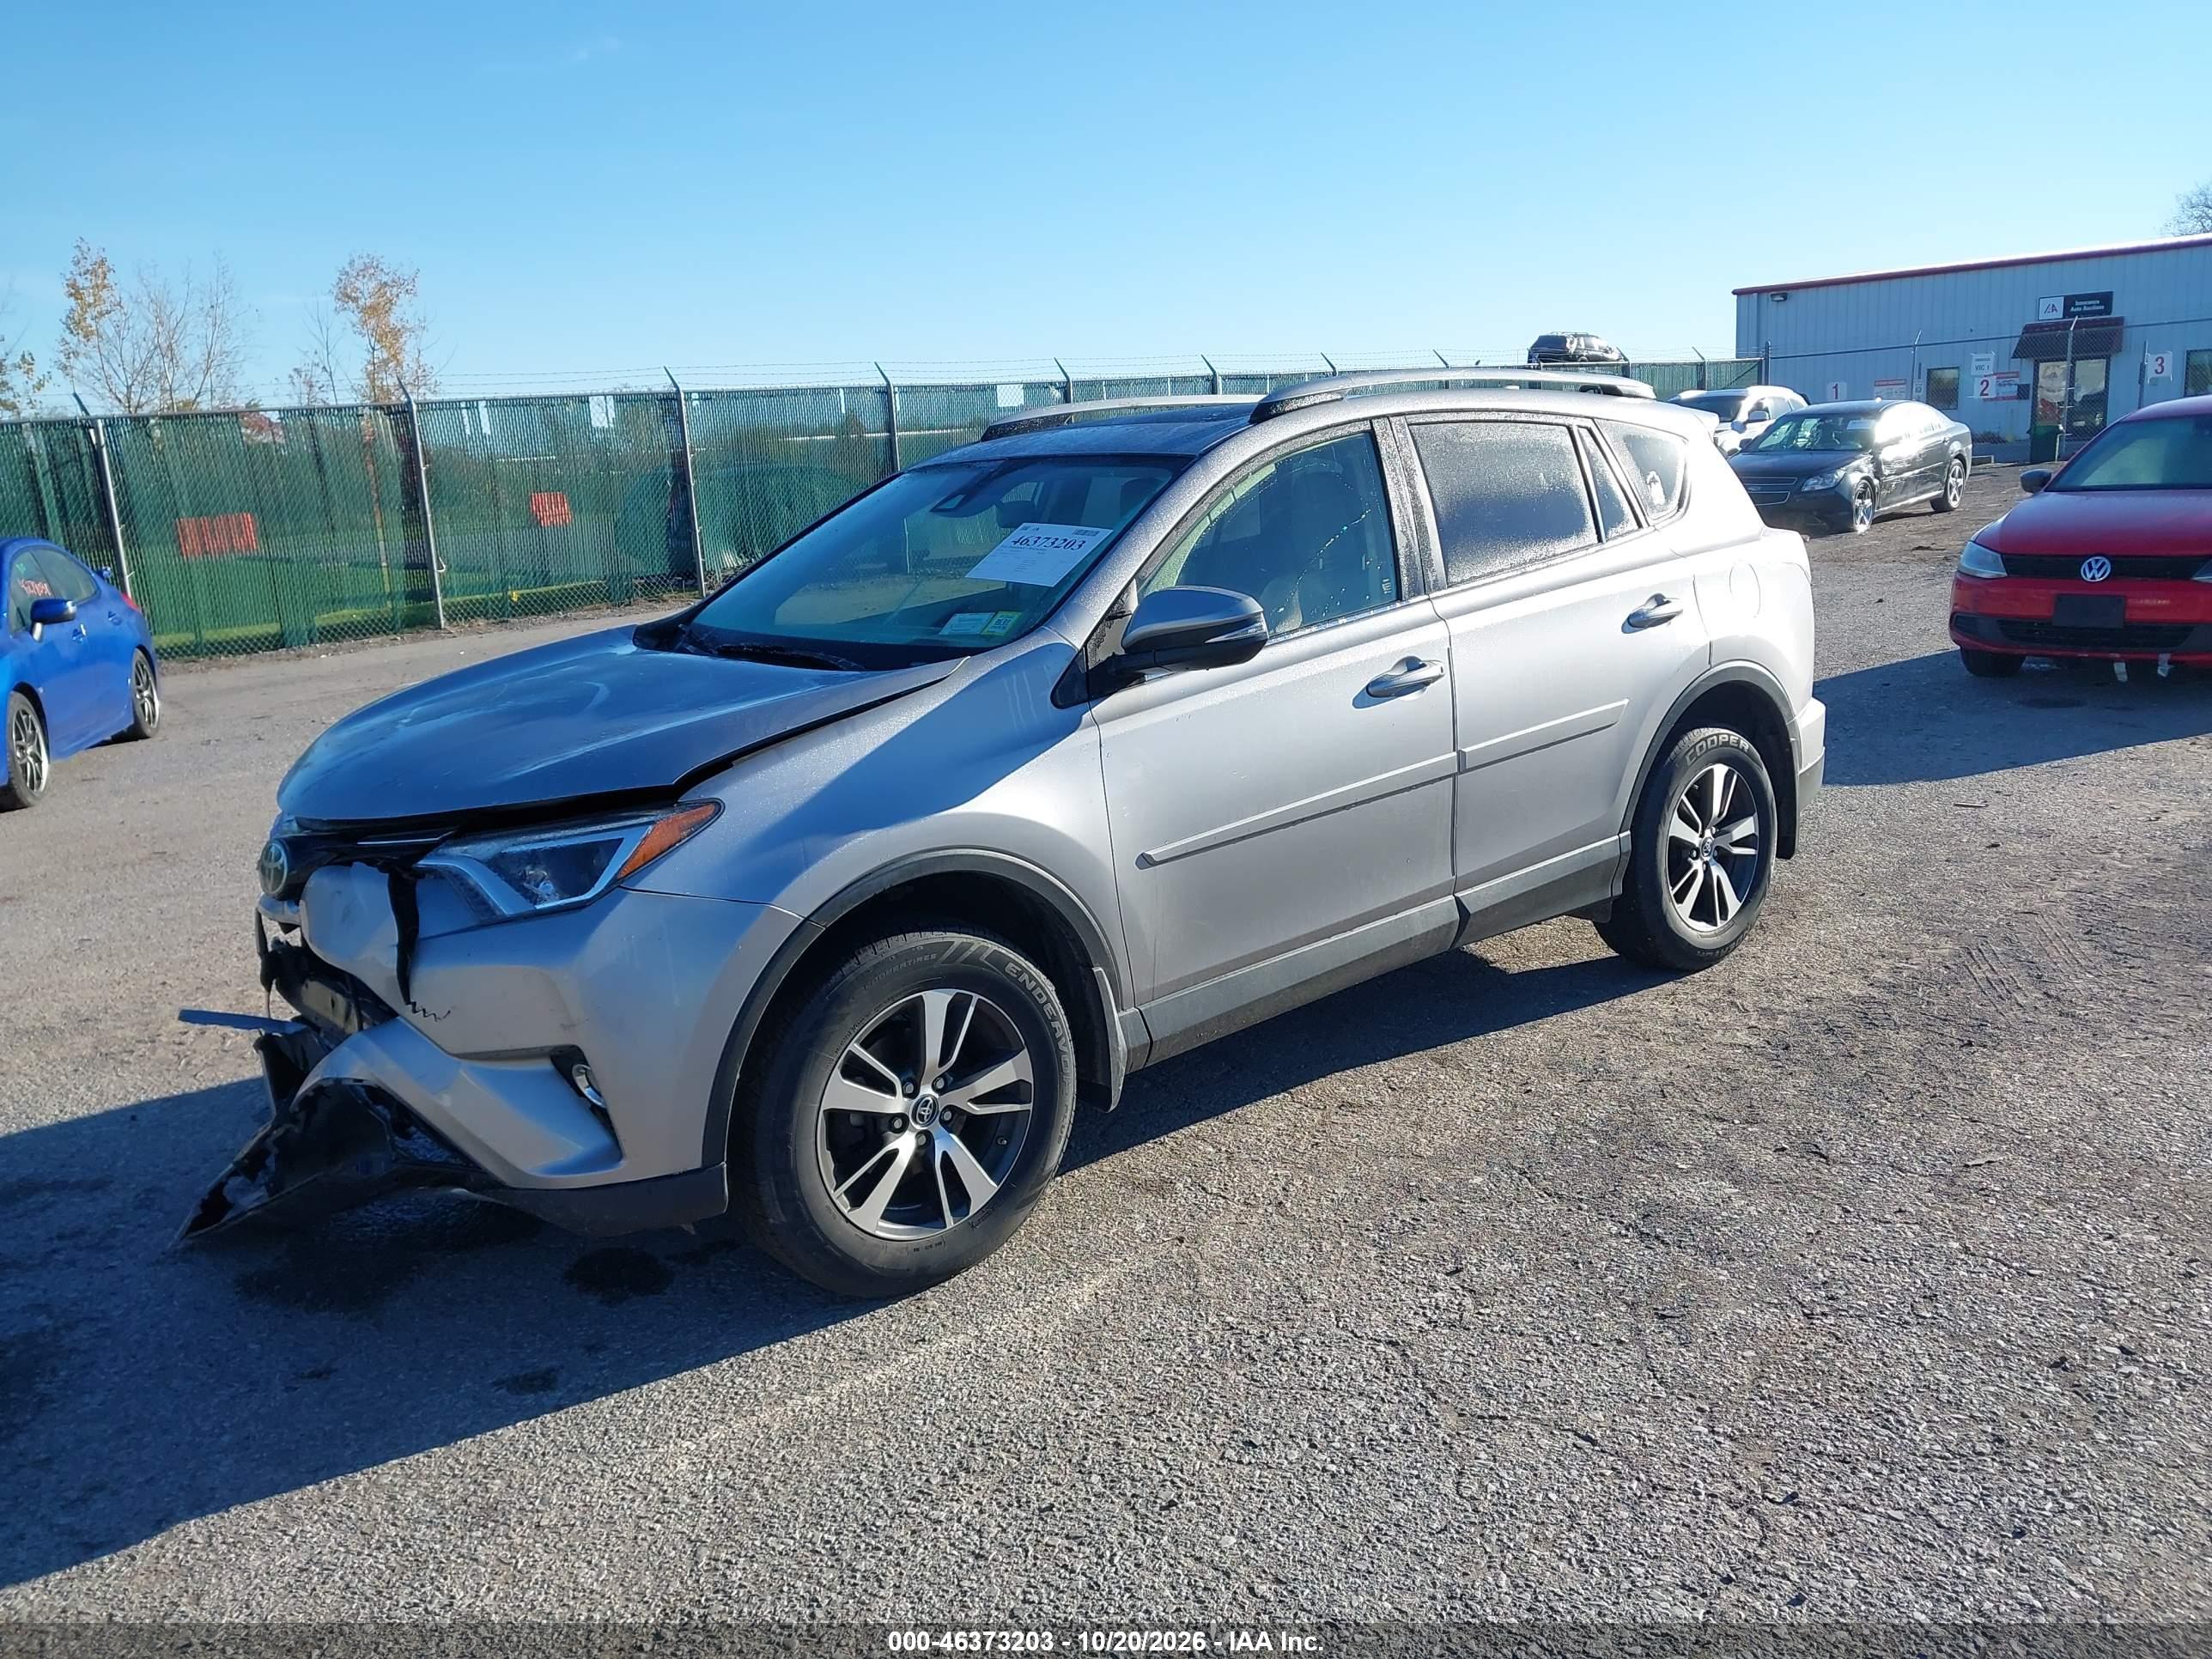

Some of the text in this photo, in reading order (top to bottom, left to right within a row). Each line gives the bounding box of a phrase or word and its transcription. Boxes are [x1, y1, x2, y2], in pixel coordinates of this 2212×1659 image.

[2154, 356, 2164, 374] 3
[1832, 383, 1838, 399] 1
[1979, 379, 1990, 396] 2
[1012, 535, 1086, 550] 46373203
[1686, 733, 1749, 767] COOPER
[1004, 961, 1074, 1097] ENDEAVOR
